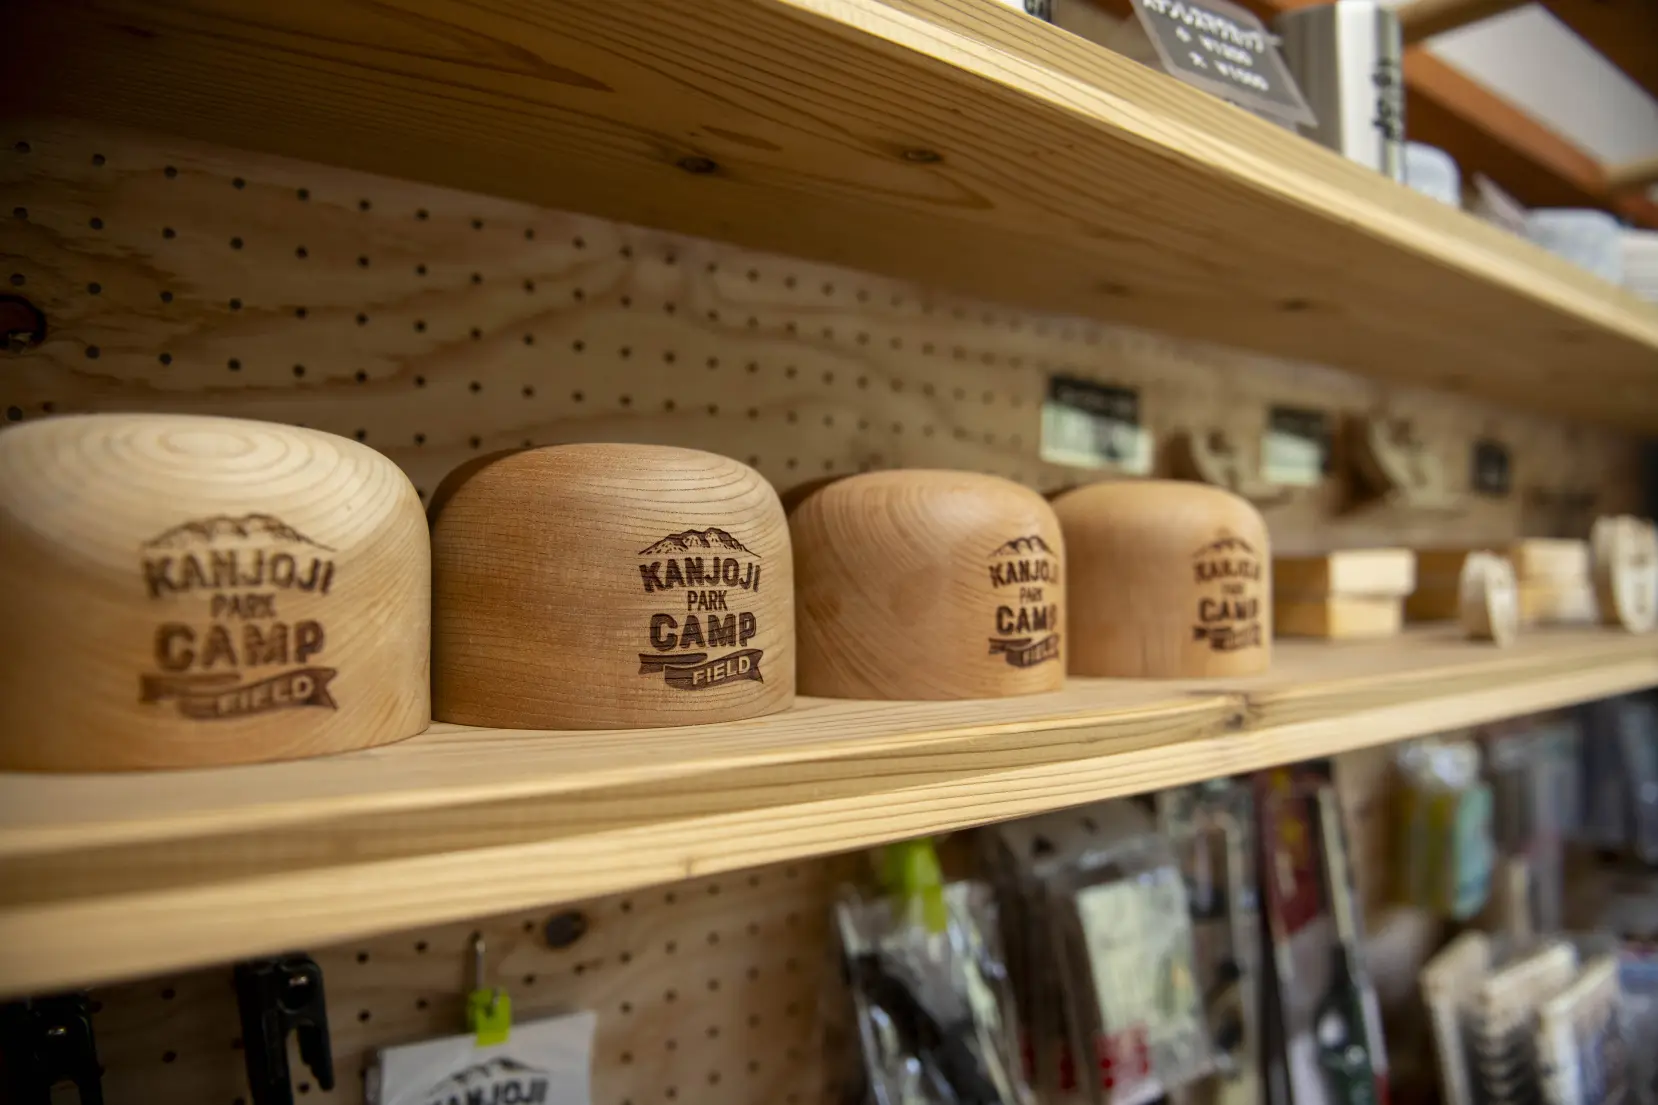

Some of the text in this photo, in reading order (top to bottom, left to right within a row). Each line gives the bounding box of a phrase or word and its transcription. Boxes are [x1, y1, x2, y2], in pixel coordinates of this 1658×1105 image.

[143, 549, 334, 598] KANJOJI
[639, 557, 761, 592] KANJOJI
[210, 592, 276, 618] PARK
[687, 590, 728, 611] PARK
[154, 620, 324, 672] CAMP
[650, 612, 757, 651] CAMP
[692, 656, 751, 685] FIELD
